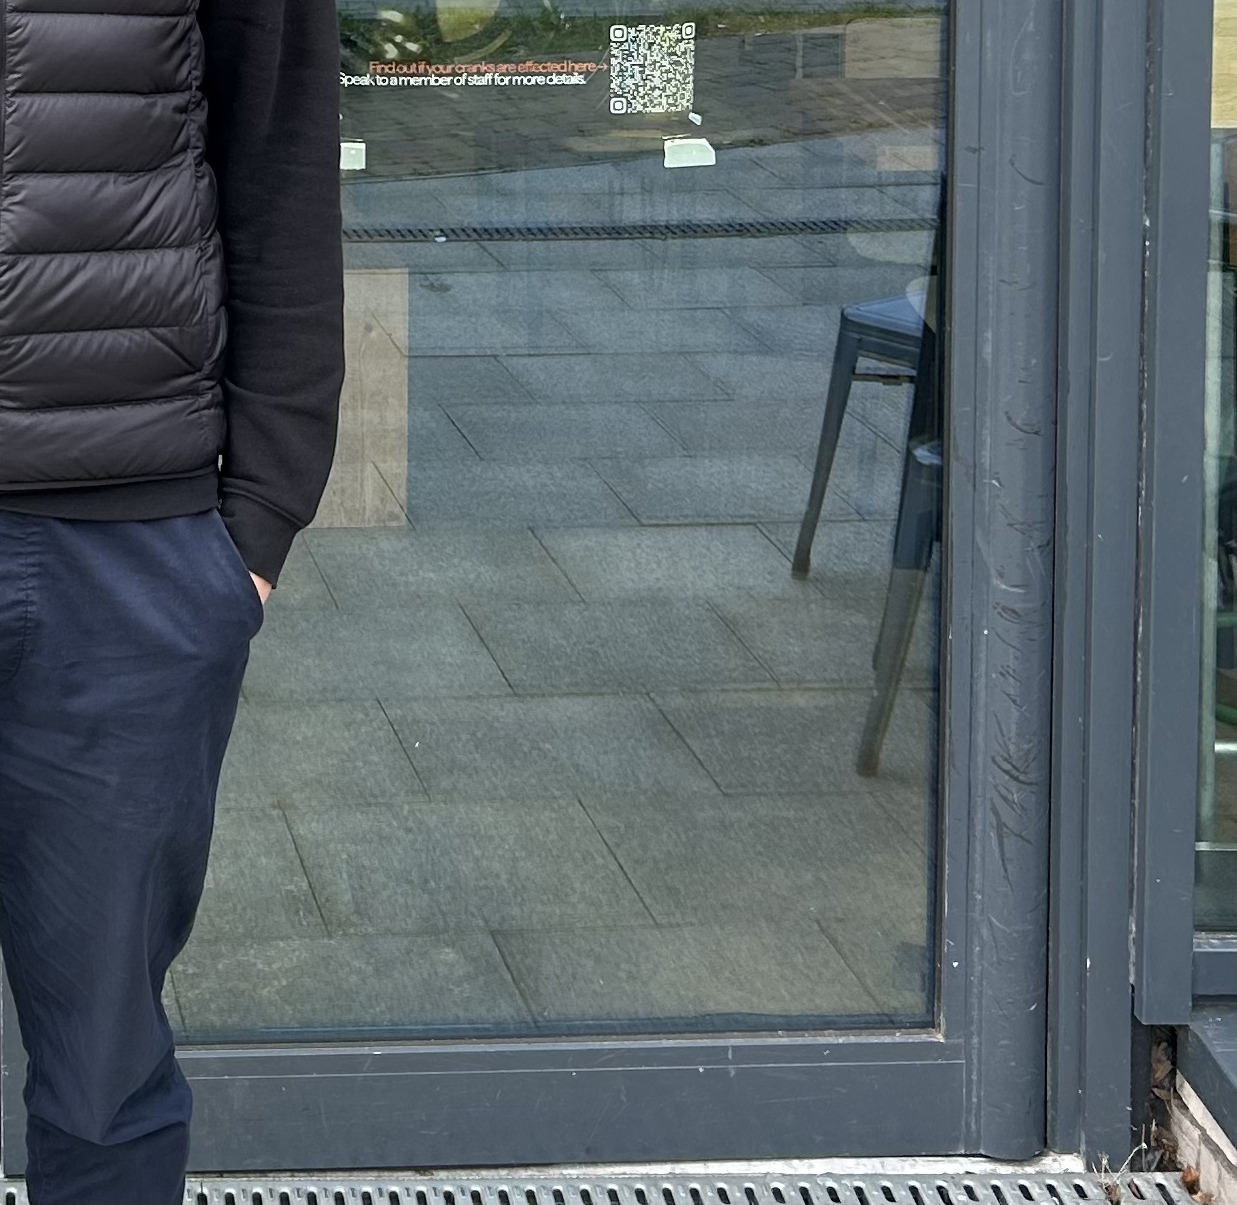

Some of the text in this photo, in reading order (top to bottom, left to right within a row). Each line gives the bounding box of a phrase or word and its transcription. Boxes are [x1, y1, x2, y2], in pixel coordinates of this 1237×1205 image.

[369, 61, 396, 74] Find
[396, 62, 418, 74] out
[427, 64, 455, 75] your
[454, 61, 495, 74] cranks
[495, 63, 517, 73] are
[568, 60, 597, 72] here
[340, 72, 587, 87] Speak to a member of staff for more details.
